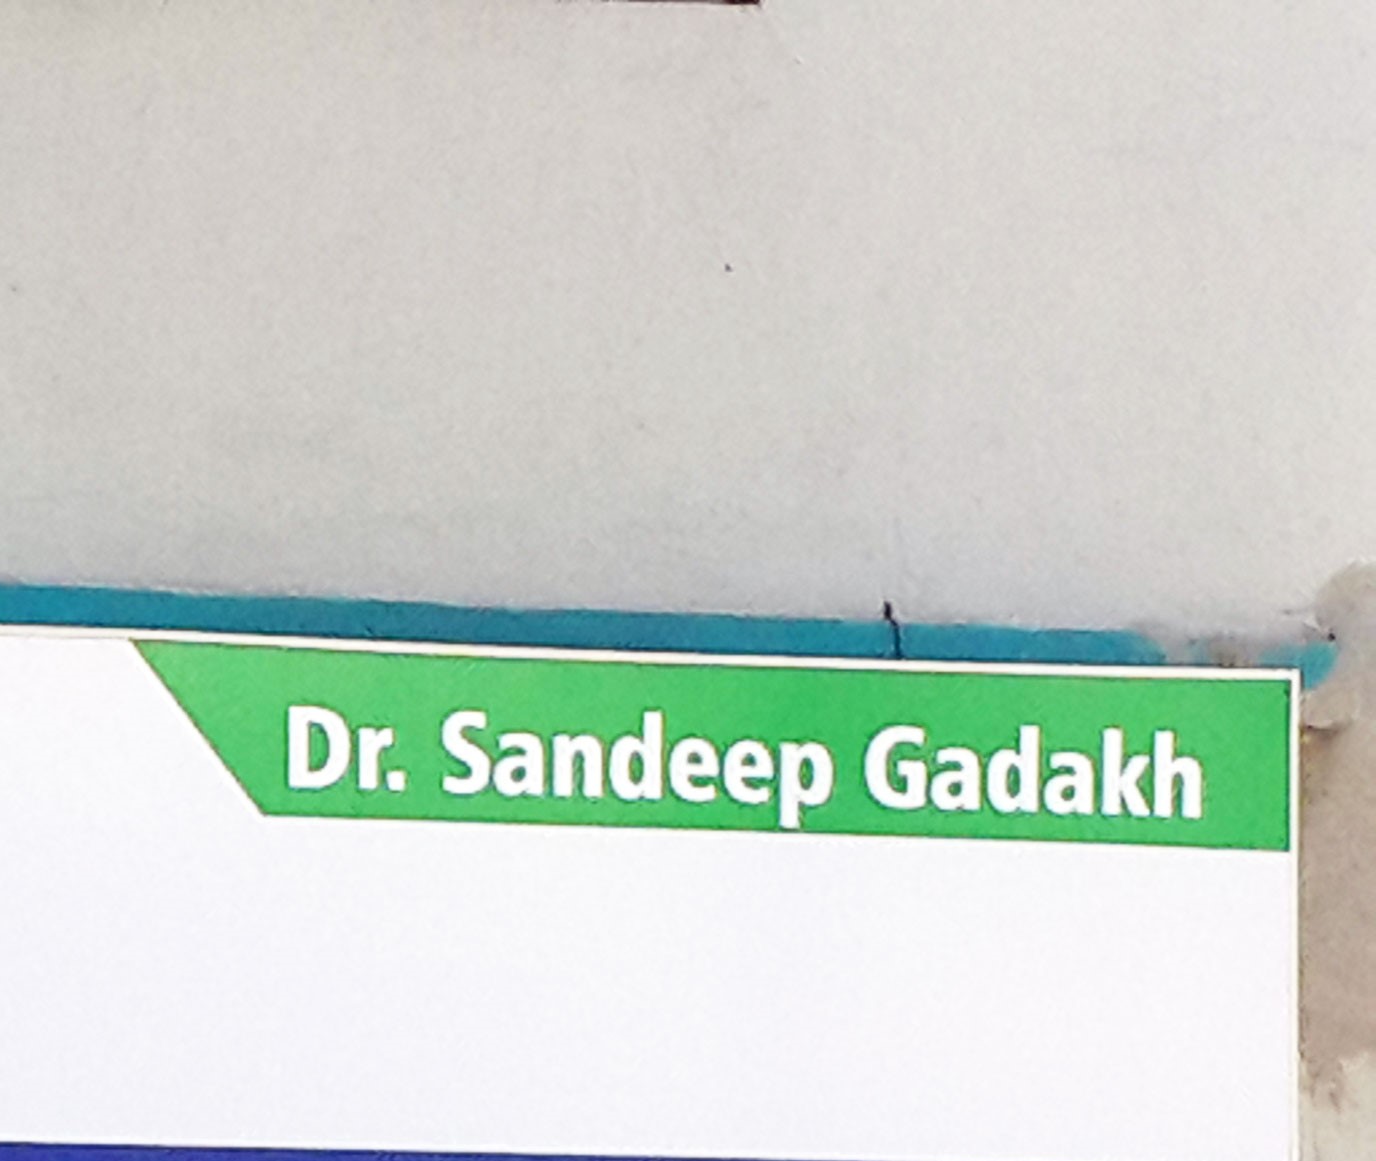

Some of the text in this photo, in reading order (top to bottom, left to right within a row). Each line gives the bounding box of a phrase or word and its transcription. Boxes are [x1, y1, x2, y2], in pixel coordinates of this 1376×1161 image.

[285, 706, 1204, 827] Dr. Sandeep Gadakh
